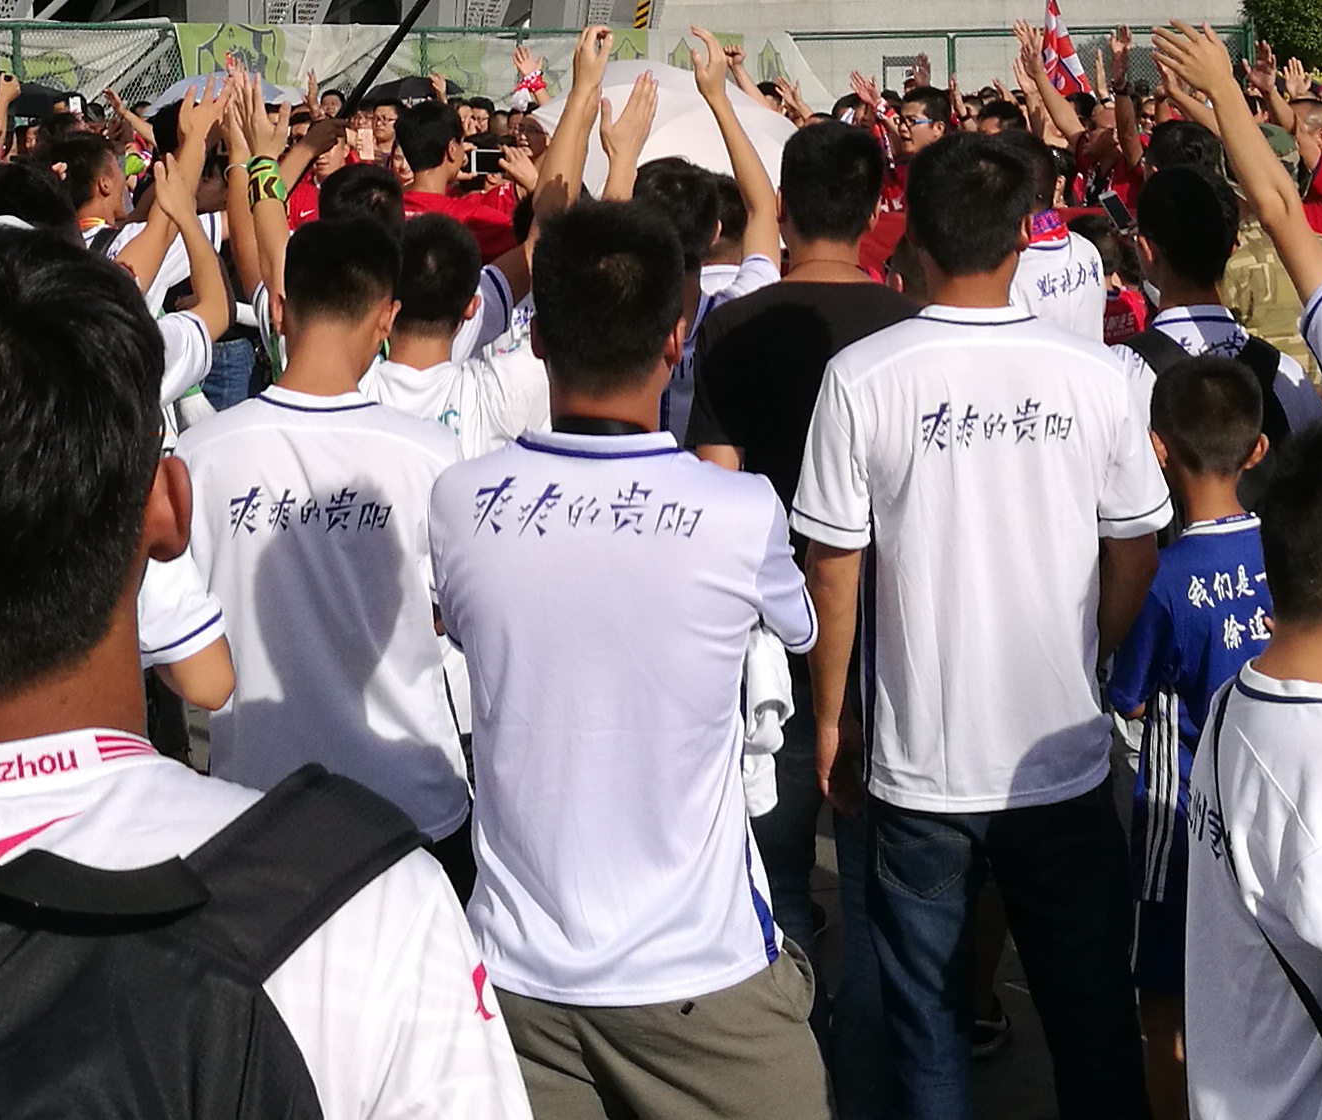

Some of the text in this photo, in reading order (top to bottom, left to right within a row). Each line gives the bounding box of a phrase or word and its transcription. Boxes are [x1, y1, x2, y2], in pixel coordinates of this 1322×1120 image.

[922, 398, 1073, 457] 爽爽的贵阳
[229, 486, 393, 539] 爽爽的贵阳
[474, 476, 703, 537] 爽爽的贵阳
